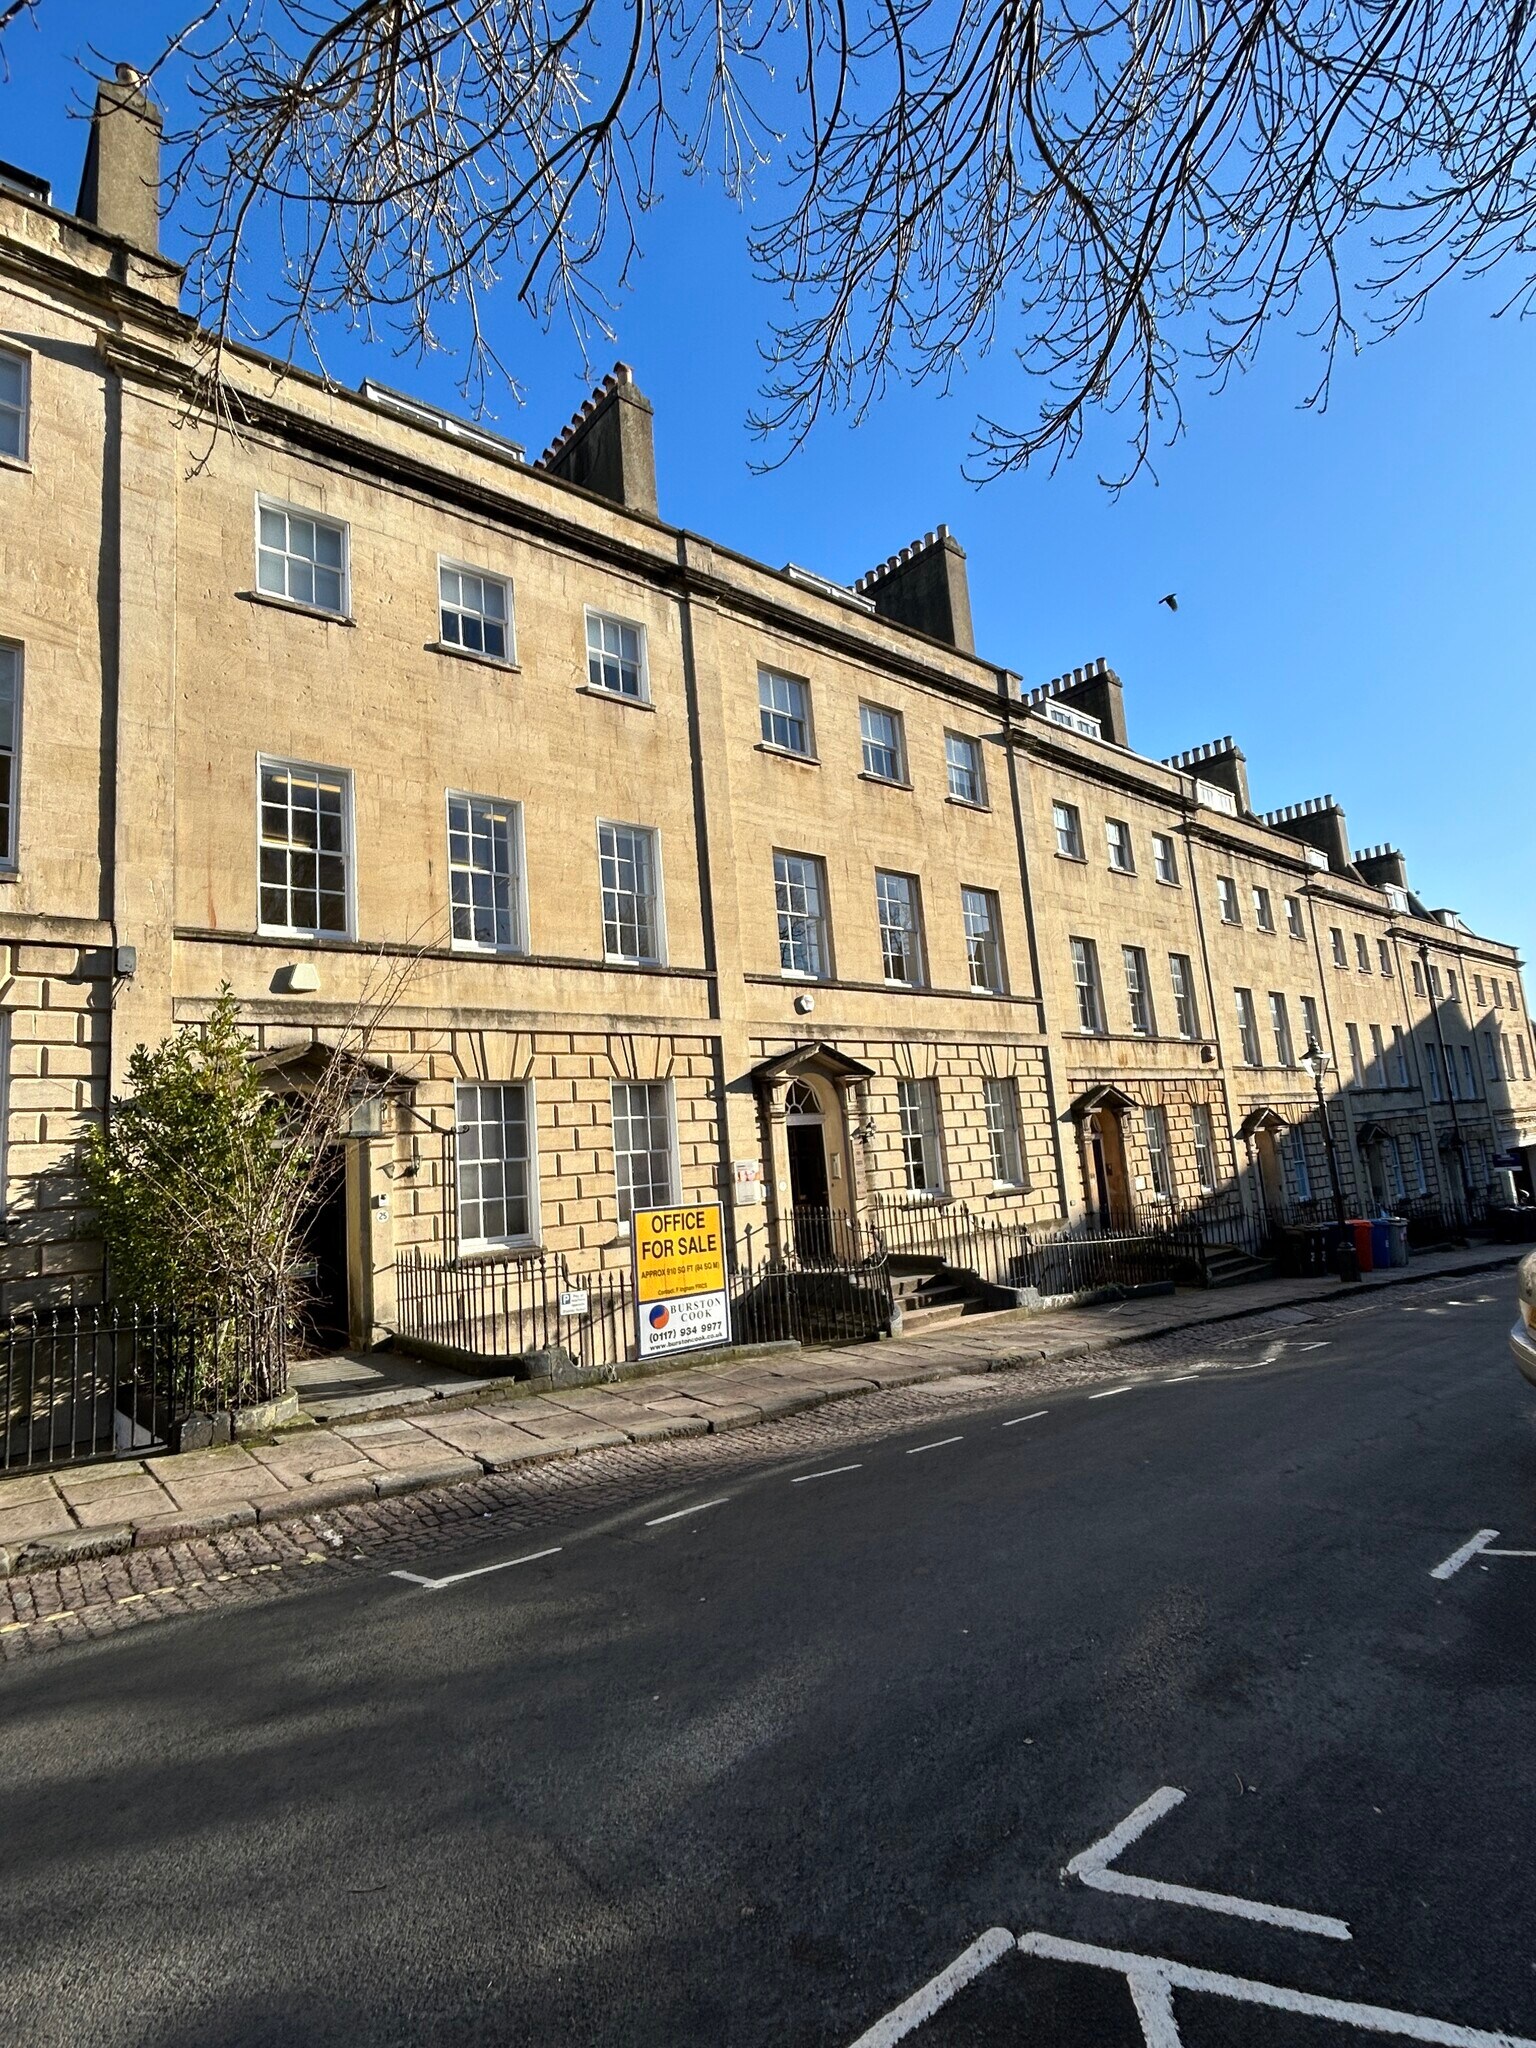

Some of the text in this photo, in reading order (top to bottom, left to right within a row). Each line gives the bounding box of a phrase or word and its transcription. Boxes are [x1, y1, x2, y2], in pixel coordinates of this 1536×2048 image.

[379, 1212, 388, 1220] 25
[652, 1211, 705, 1233] OFFICE
[642, 1234, 717, 1260] FOR SALE
[641, 1269, 665, 1279] APPROX
[678, 1266, 685, 1274] SQ
[563, 1294, 570, 1304] P
[671, 1298, 721, 1314] BURSTON
[681, 1309, 712, 1322] COOK
[650, 1321, 722, 1343] (0117) 934 9977
[650, 1332, 723, 1351] www.burstoncook.co.uk
